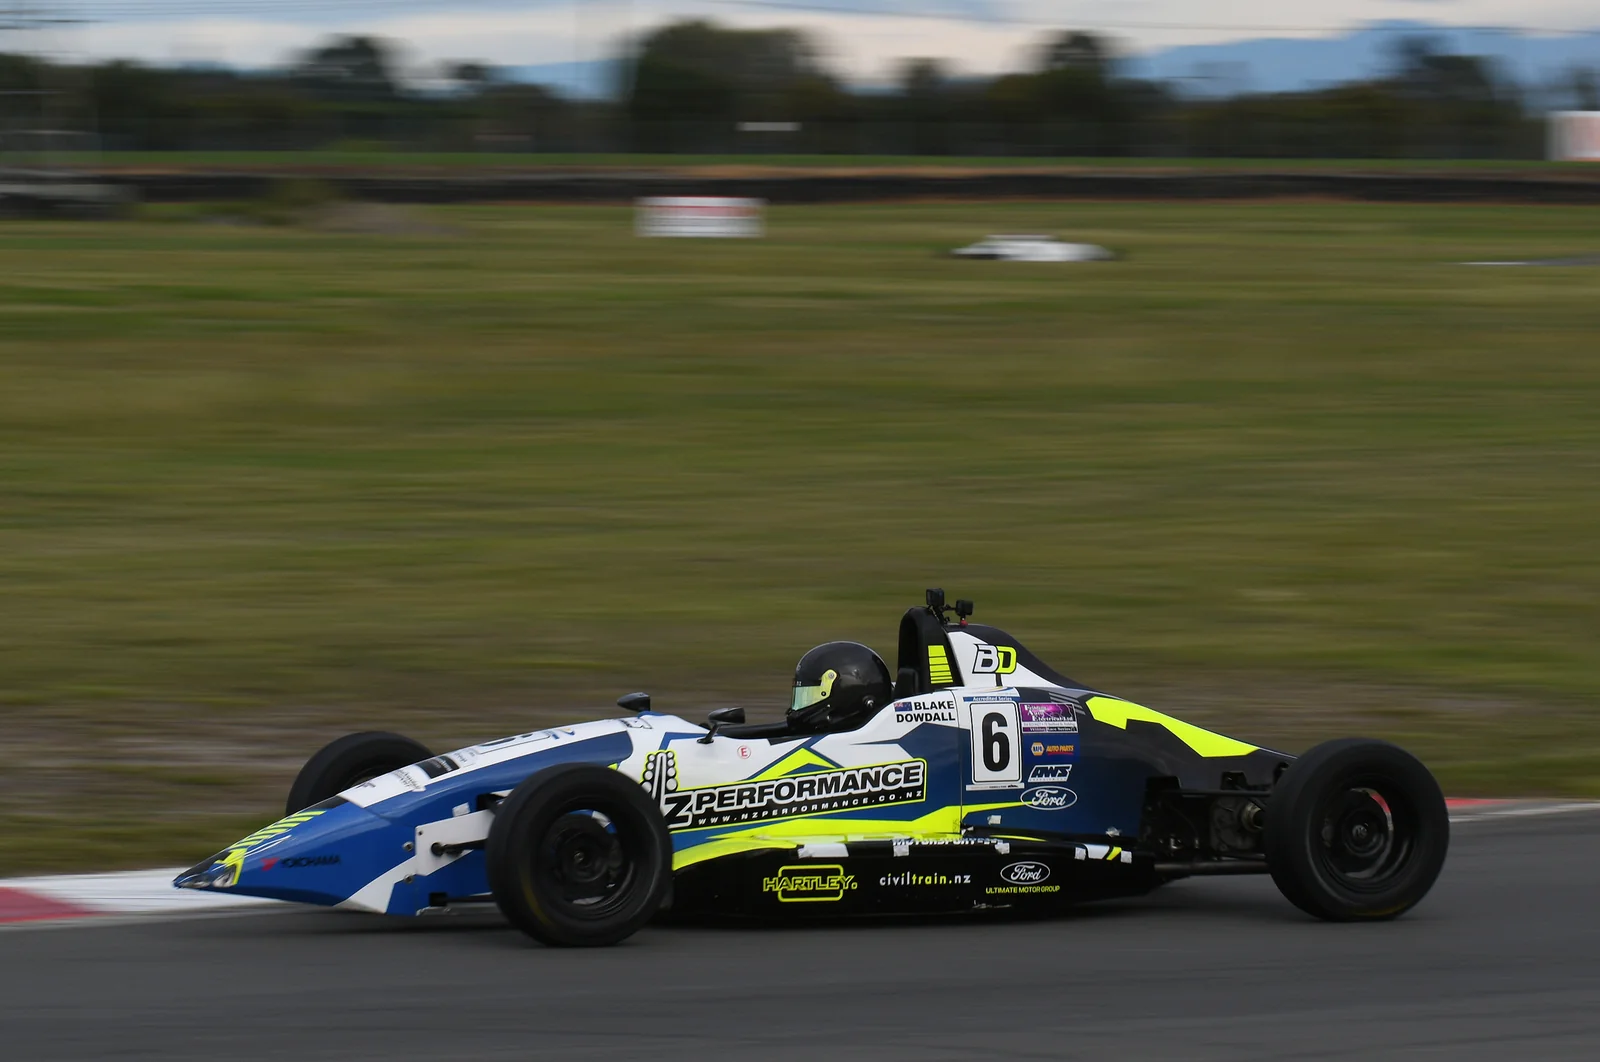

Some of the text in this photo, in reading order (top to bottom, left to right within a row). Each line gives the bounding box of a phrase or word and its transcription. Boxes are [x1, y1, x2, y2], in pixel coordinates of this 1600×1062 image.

[914, 701, 955, 710] BLAKE
[896, 712, 956, 723] DOWDALL
[981, 712, 1010, 772] 6
[740, 748, 748, 757] E
[1032, 789, 1066, 806] Ford
[879, 871, 971, 886] civiltrain.nz
[1011, 864, 1042, 880] Ford
[985, 886, 1018, 894] ULTIMATE
[1018, 885, 1040, 893] MOTOR
